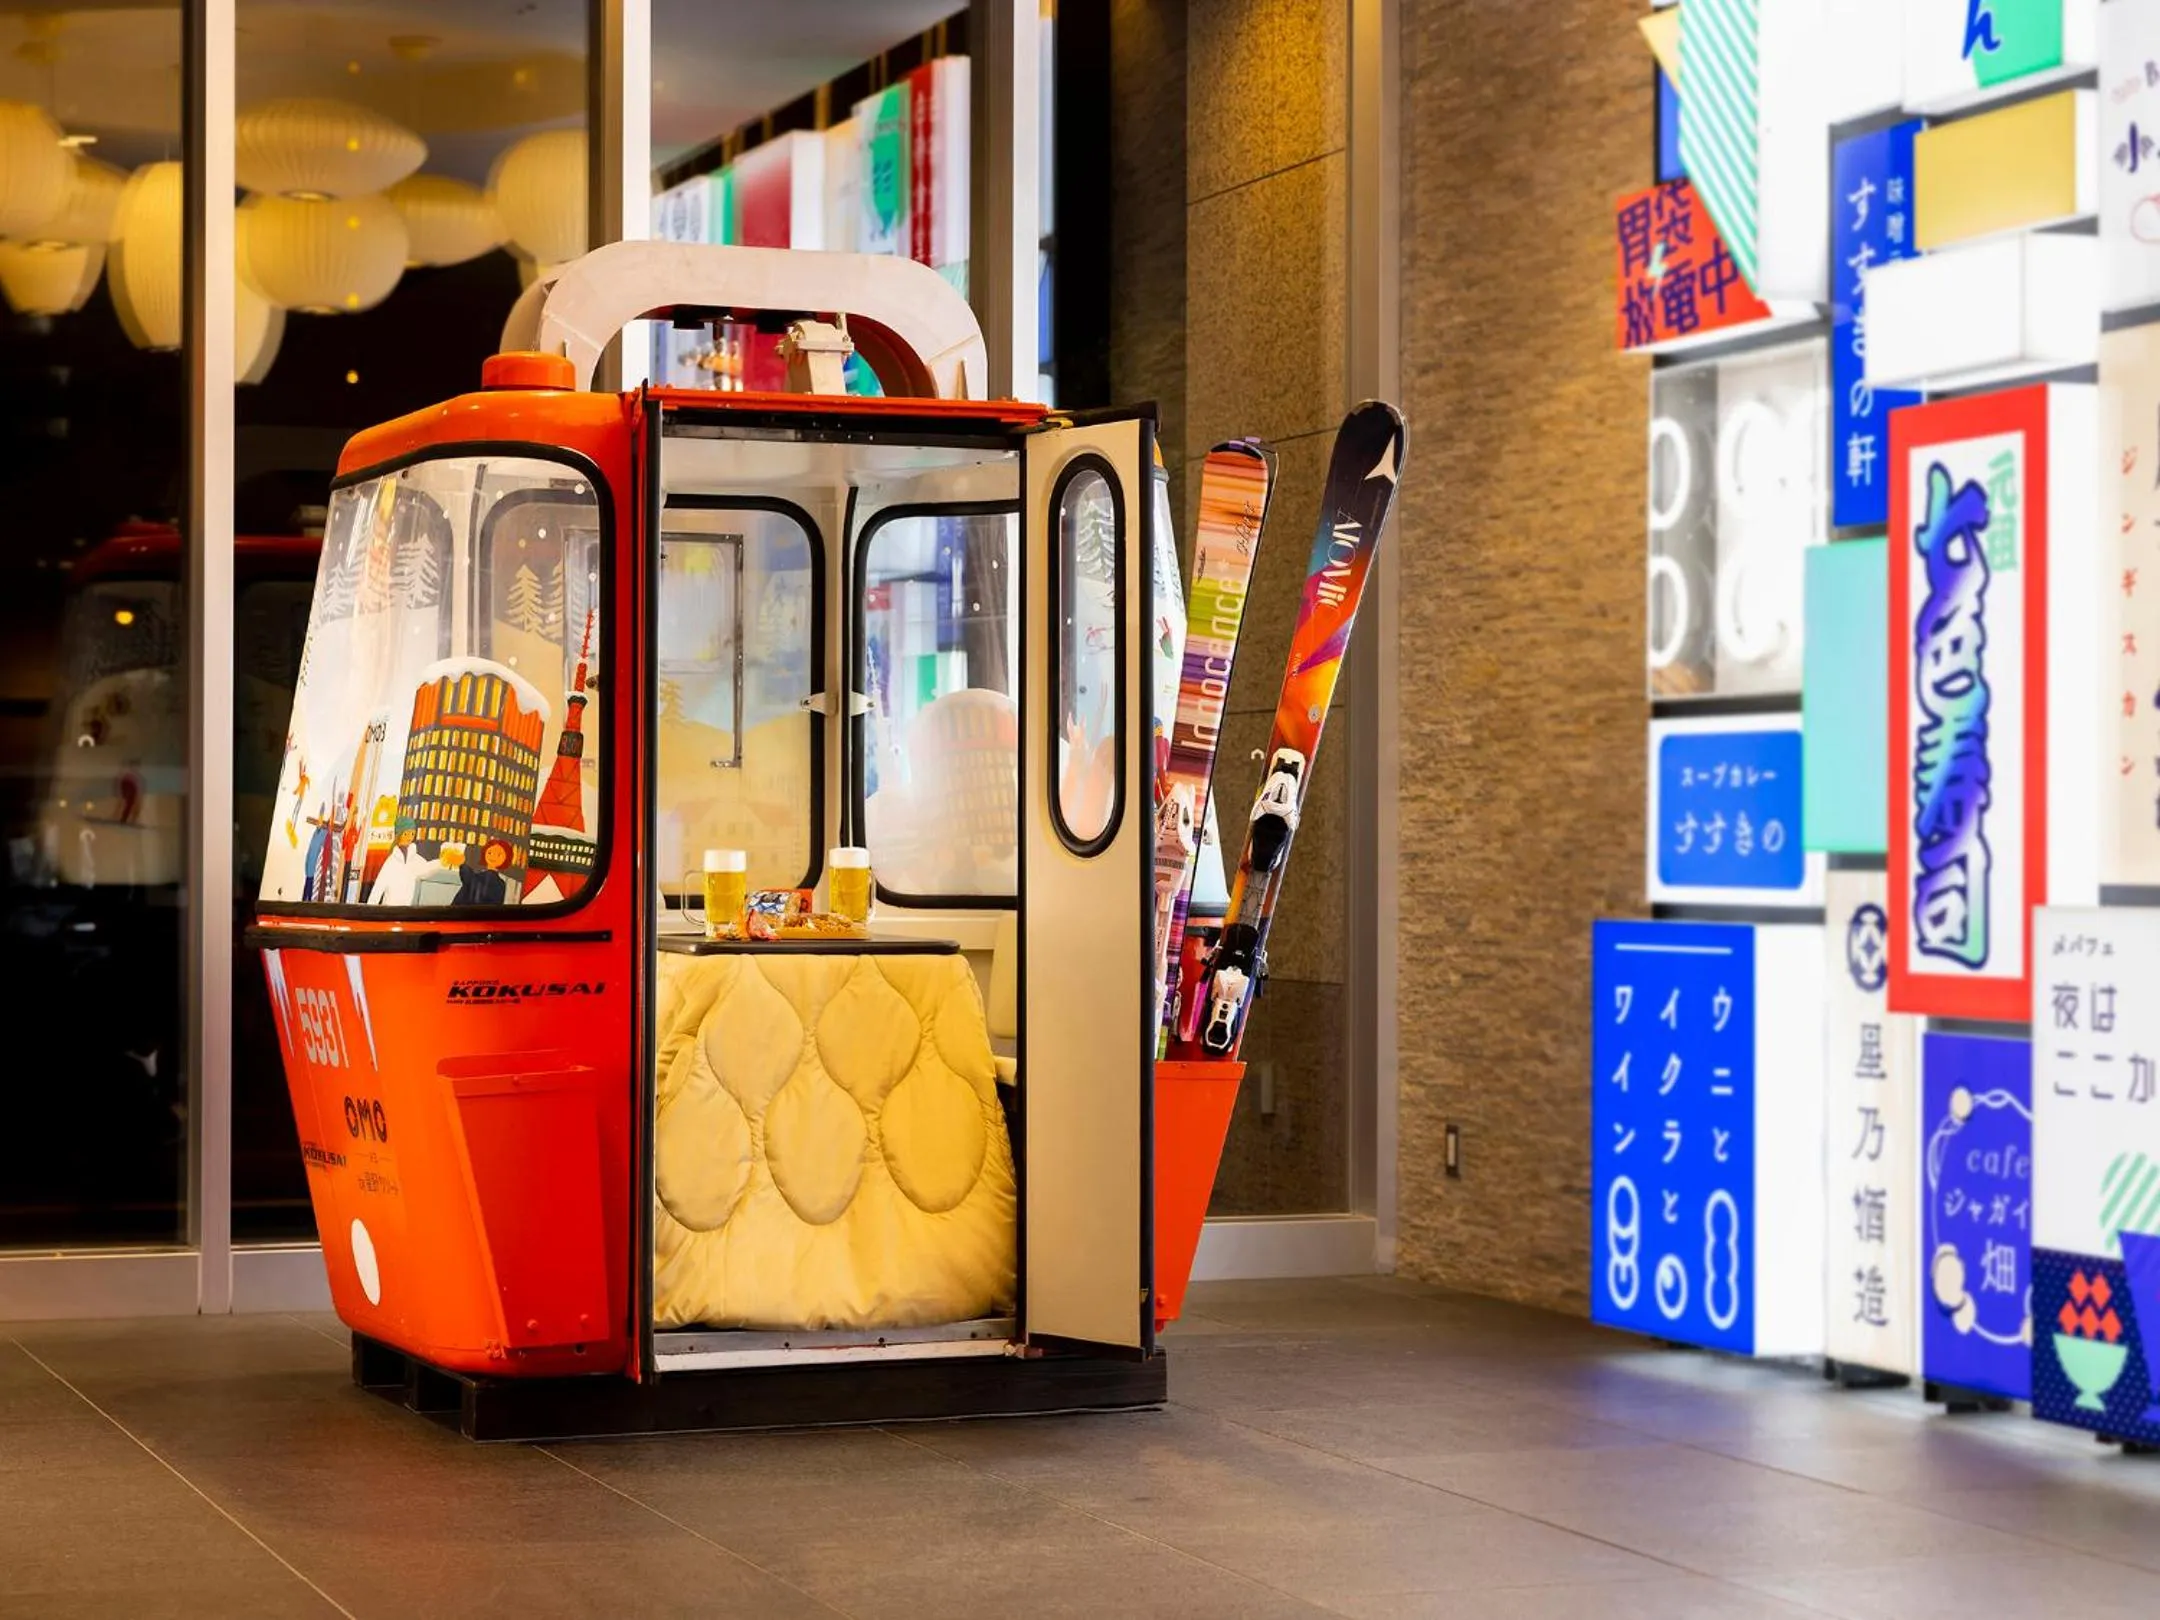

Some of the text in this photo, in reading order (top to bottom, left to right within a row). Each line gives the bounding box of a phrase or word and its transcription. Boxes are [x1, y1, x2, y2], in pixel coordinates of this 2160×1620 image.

[2121, 445, 2139, 776] ジンギスカン
[1681, 761, 1777, 789] スープカレー
[1675, 810, 1785, 857] すすきの
[447, 981, 607, 999] KOKUSAI
[2052, 981, 2117, 1032] 夜は
[295, 987, 349, 1068] 5931
[1612, 985, 1636, 1154] ワイン
[1711, 986, 1734, 1163] ウニと
[2053, 1051, 2157, 1104] ここか
[343, 1095, 387, 1143] OMO
[1658, 988, 1682, 1224] イクラと
[1966, 1144, 2030, 1180] cafe
[1980, 1238, 2016, 1294] 畑
